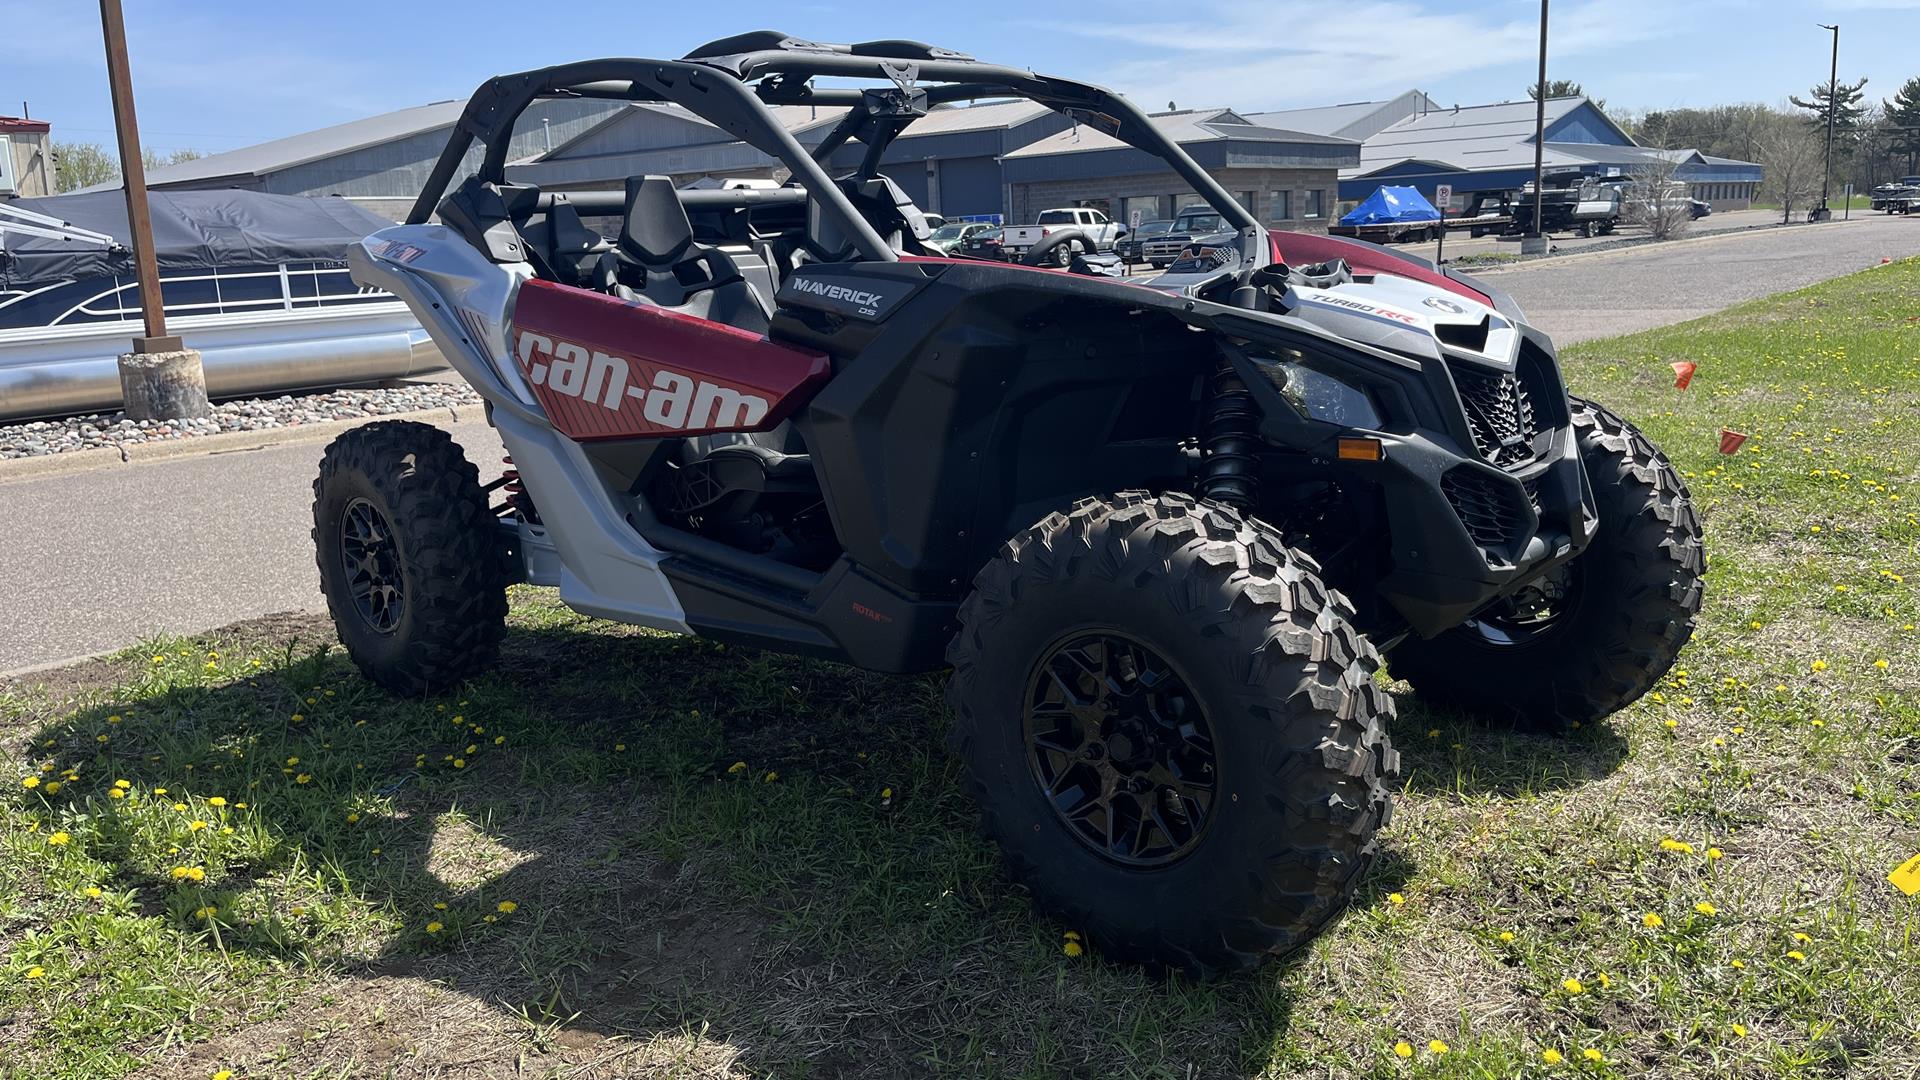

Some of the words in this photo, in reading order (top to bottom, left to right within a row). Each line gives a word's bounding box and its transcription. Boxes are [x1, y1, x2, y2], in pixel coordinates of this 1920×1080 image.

[793, 277, 883, 308] MAVERICK
[857, 306, 877, 316] DS
[1312, 295, 1375, 312] TURBO
[1376, 308, 1415, 323] RR
[518, 331, 769, 430] can-am
